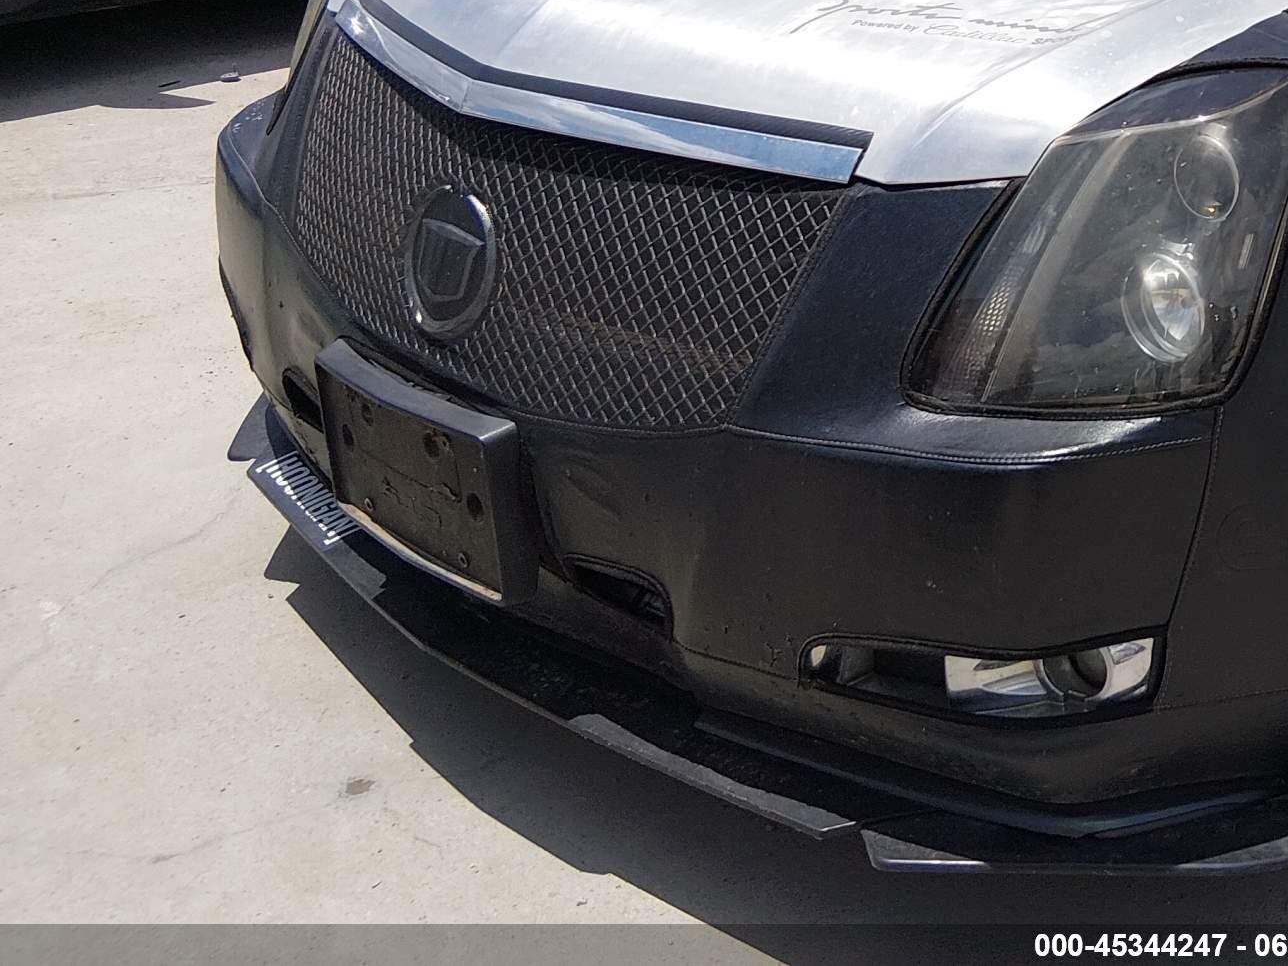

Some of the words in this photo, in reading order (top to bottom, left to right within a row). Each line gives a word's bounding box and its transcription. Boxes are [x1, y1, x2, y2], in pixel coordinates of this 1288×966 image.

[851, 18, 904, 31] Powered
[903, 22, 920, 33] by
[922, 24, 1028, 46] Cadillac
